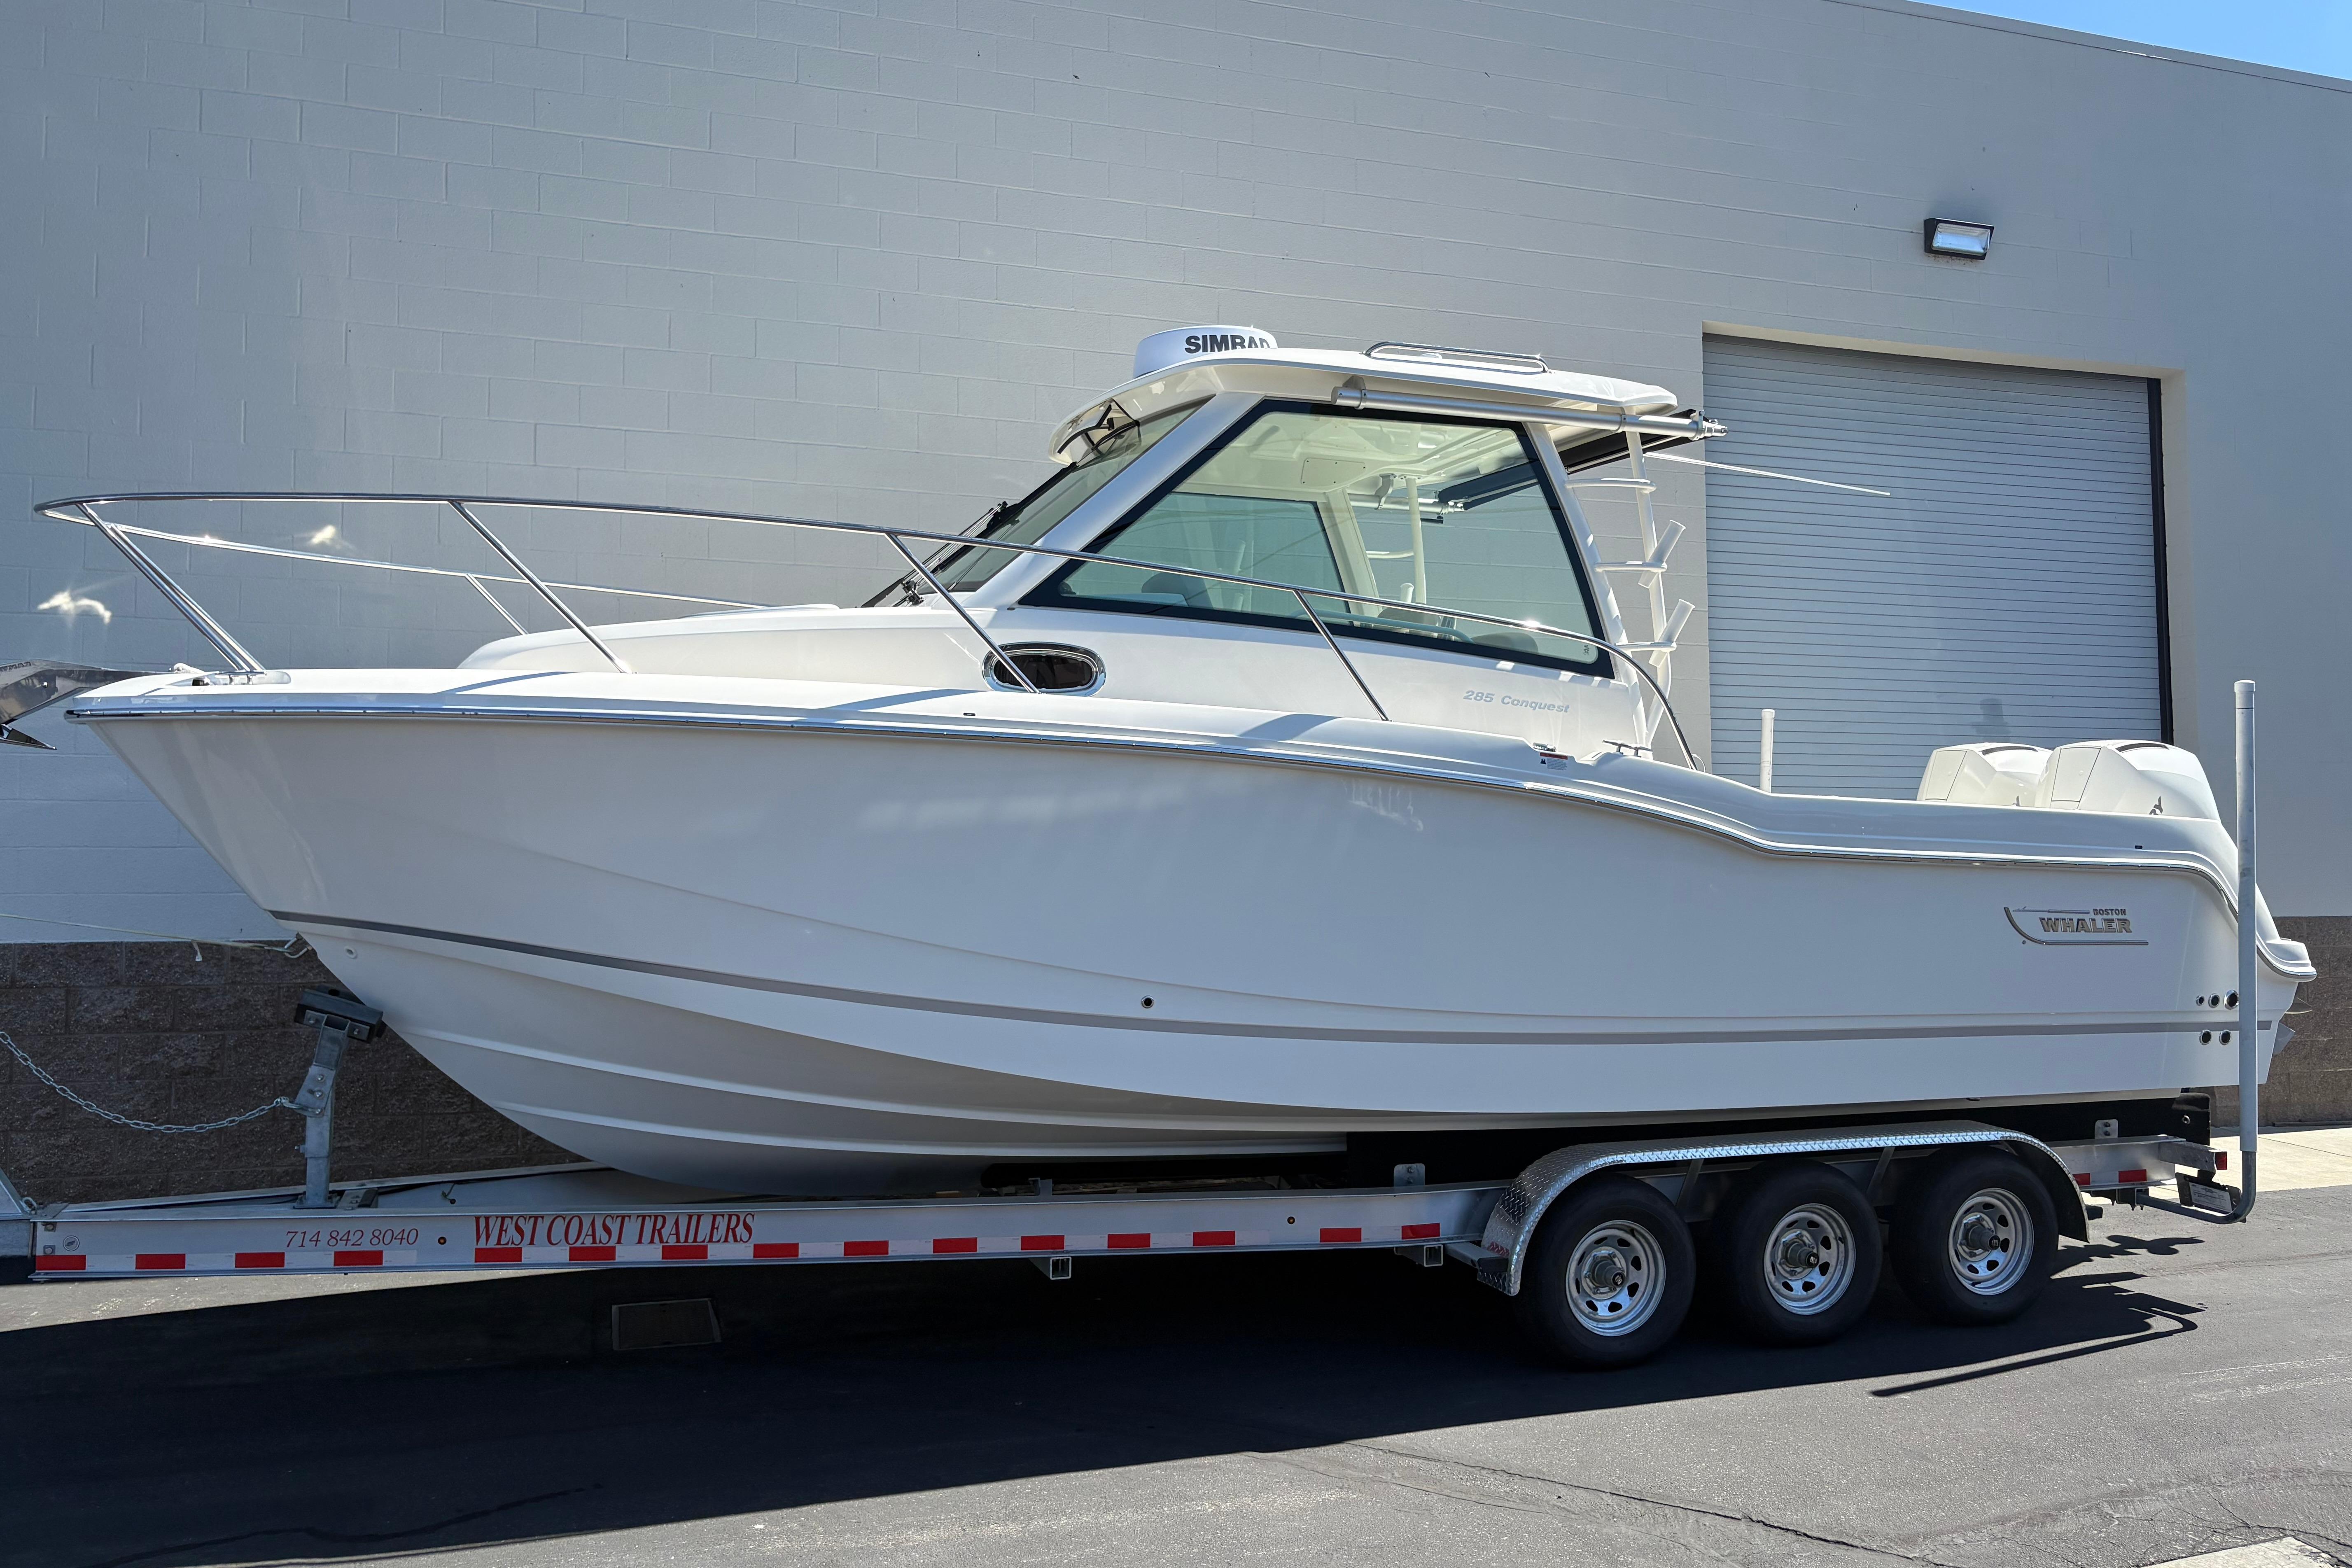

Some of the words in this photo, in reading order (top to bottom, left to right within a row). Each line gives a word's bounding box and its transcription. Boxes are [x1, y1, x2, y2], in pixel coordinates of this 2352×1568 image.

[1185, 335, 1270, 353] SIMRAD
[1463, 690, 1495, 702] 285
[1501, 695, 1570, 713] Conquest
[2039, 917, 2132, 933] WHALER
[286, 1230, 321, 1247] 714
[327, 1229, 364, 1247] 842
[369, 1228, 419, 1246] 8040
[474, 1215, 544, 1246] WEST
[546, 1214, 631, 1246] COAST
[635, 1213, 755, 1244] TRAILERS
